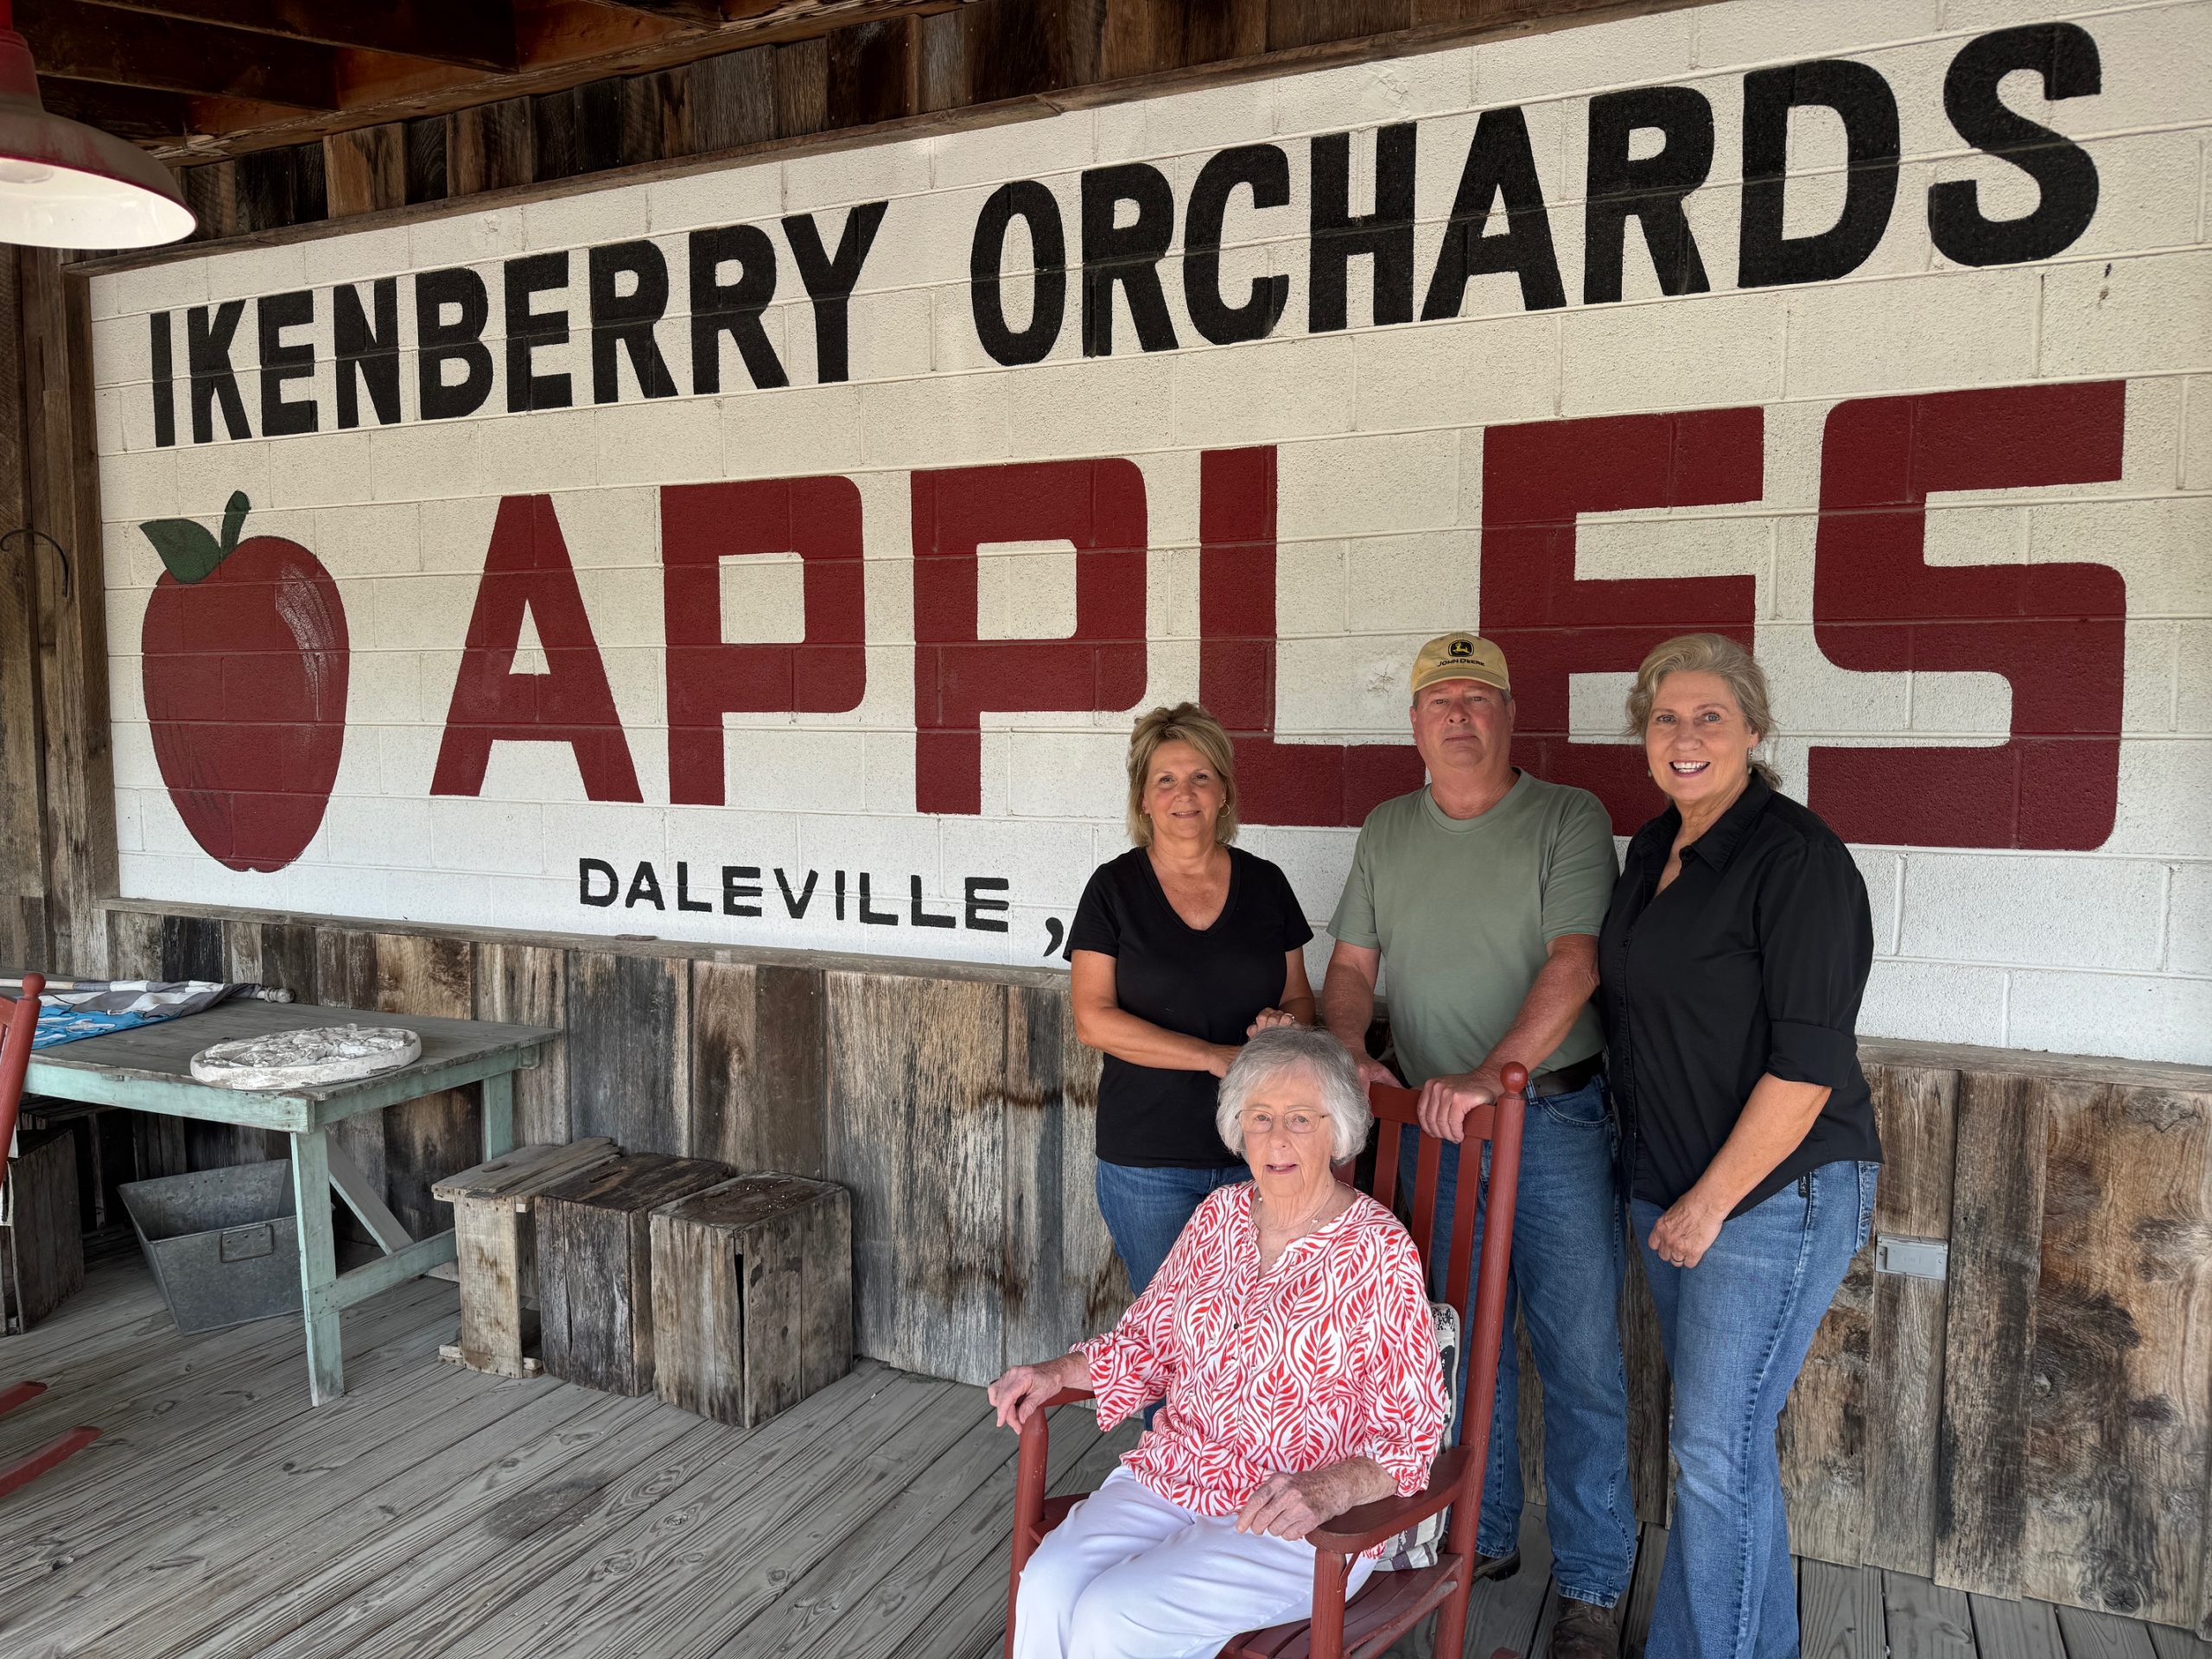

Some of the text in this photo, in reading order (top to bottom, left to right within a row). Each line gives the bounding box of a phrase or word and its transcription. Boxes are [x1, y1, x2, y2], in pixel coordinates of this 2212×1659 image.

[150, 22, 2102, 448] IKENBERRY ORCHARDS
[432, 380, 2125, 851] APPLES
[1437, 658, 1485, 667] JOHN DEERE
